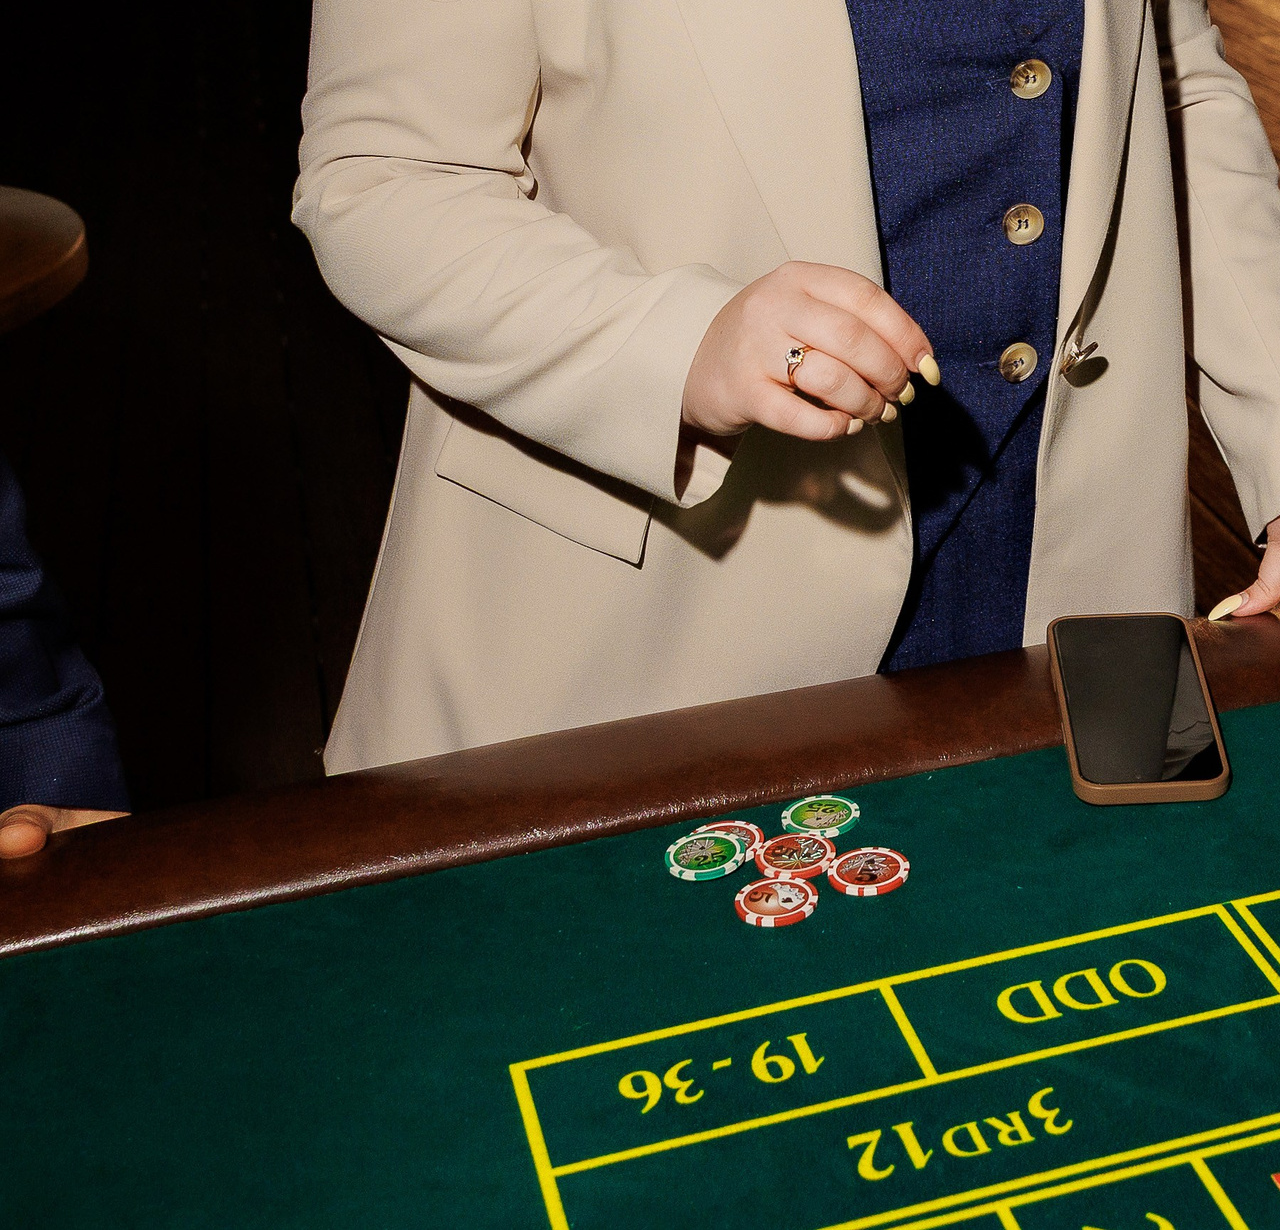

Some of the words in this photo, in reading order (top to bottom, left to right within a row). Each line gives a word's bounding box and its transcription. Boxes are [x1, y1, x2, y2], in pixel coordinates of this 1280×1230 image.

[807, 802, 839, 814] 25
[694, 849, 728, 866] 25
[749, 891, 774, 904] 5
[997, 959, 1166, 1023] ODD
